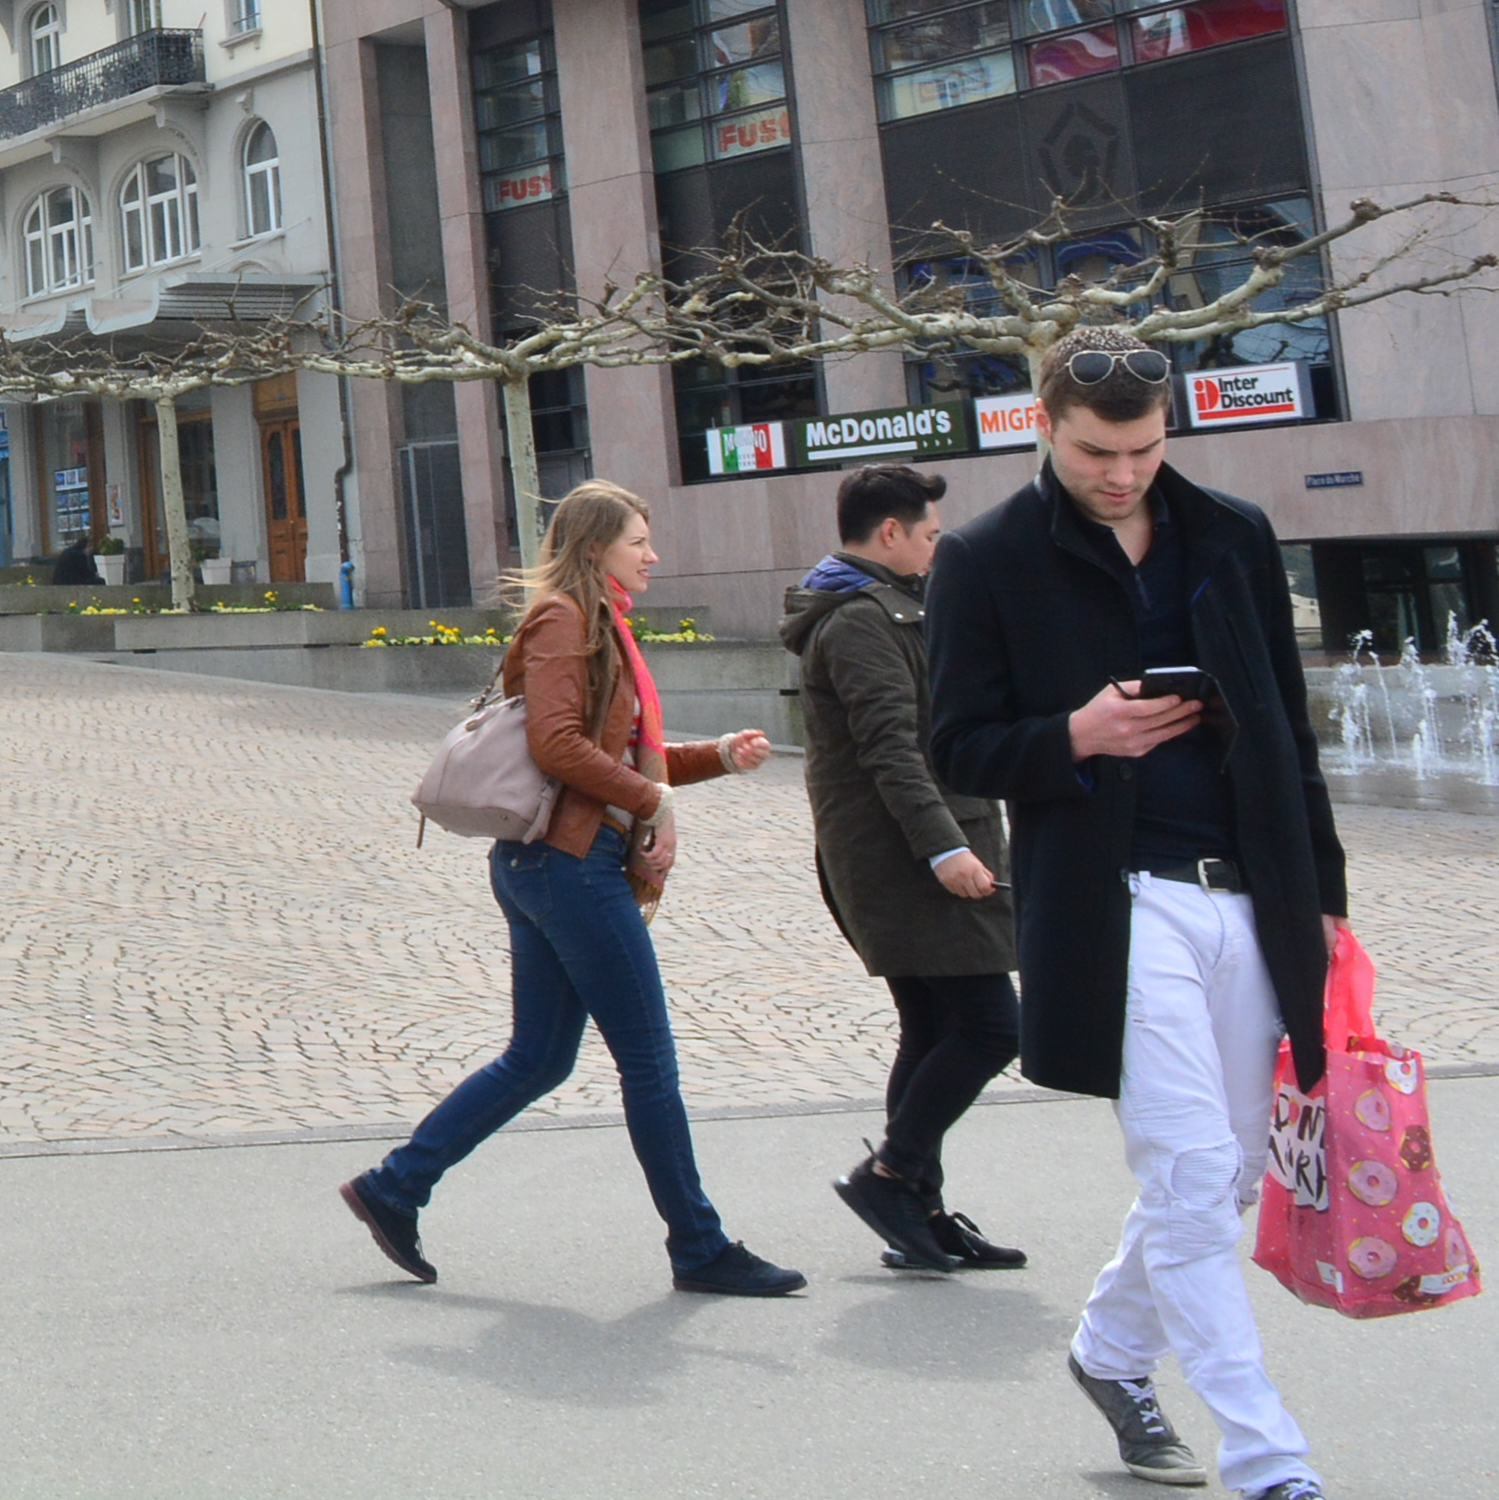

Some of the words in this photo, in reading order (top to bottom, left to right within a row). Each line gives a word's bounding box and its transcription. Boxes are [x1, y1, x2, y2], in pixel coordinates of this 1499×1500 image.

[1218, 377, 1259, 392] Inter
[1220, 388, 1294, 409] Discount
[806, 409, 951, 447] McDonald's
